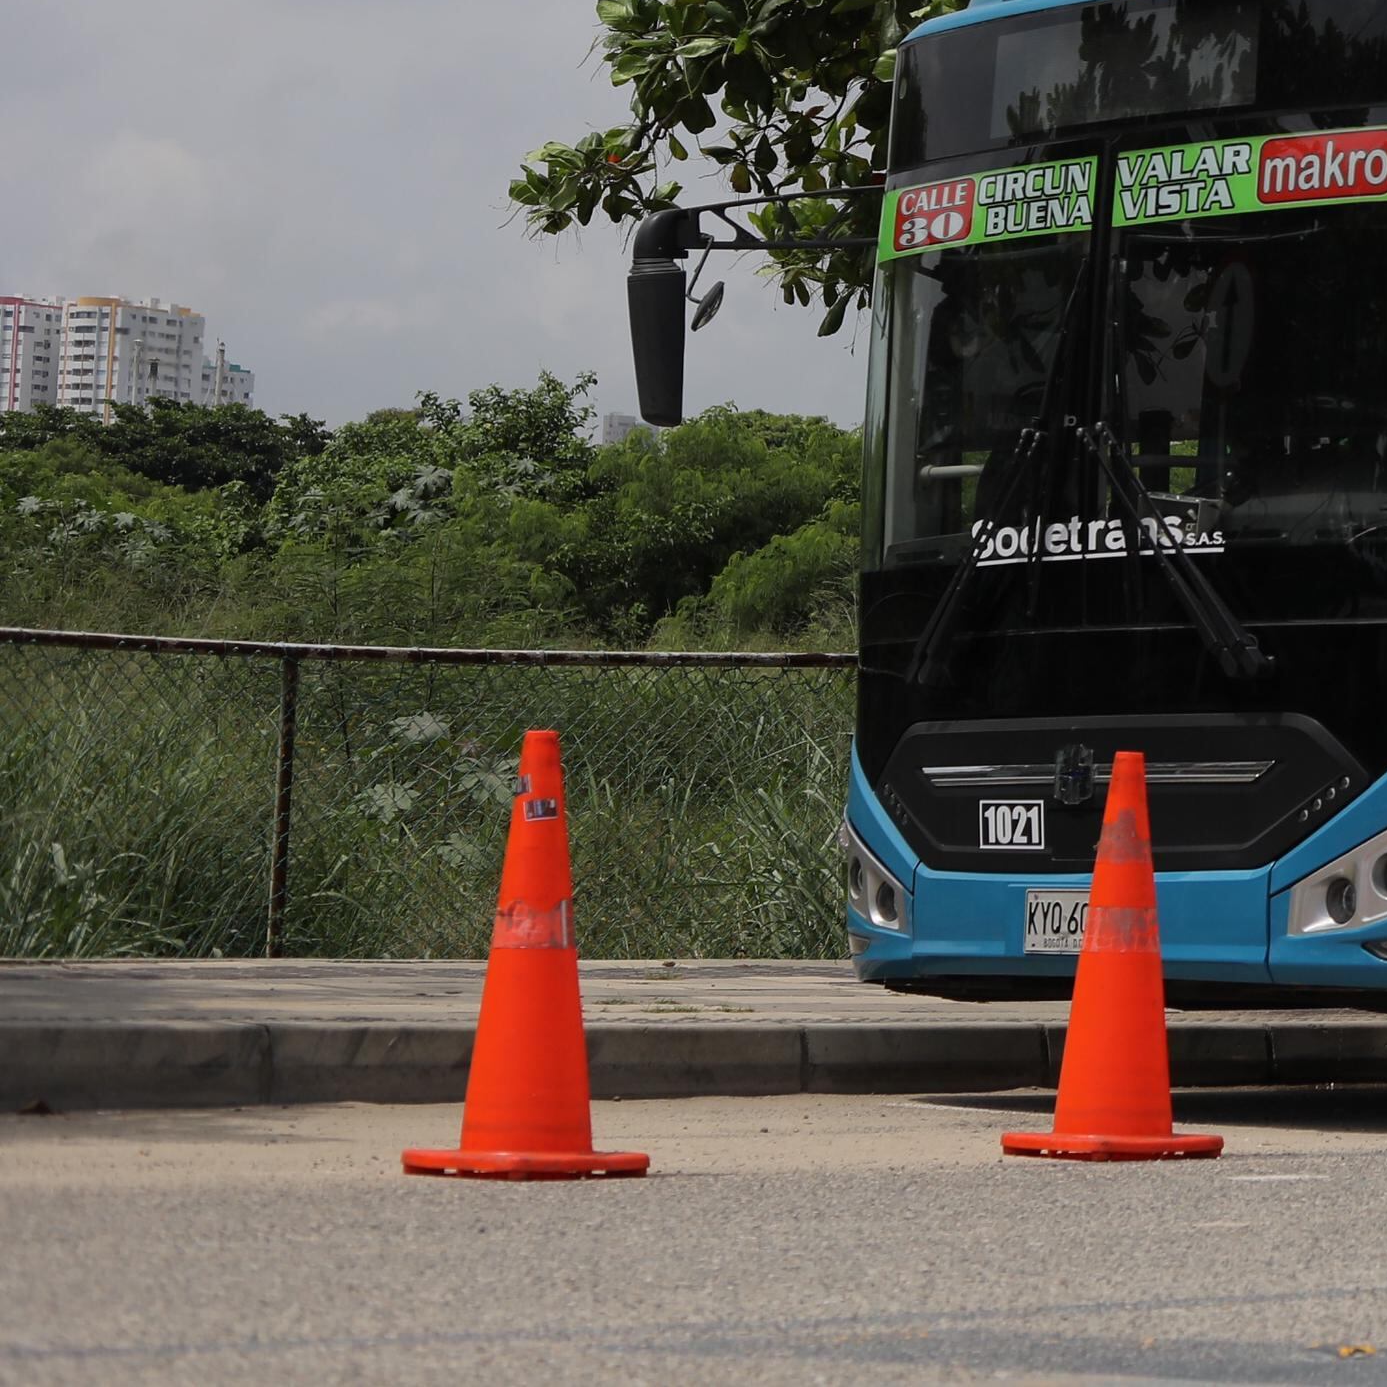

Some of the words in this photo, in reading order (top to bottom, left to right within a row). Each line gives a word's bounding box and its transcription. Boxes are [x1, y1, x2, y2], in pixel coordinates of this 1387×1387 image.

[977, 162, 1092, 207] CIRCUN
[1117, 143, 1252, 187] VALAR
[901, 181, 968, 216] CALLE
[984, 194, 1093, 237] BUENA
[1120, 179, 1235, 219] VISTA
[898, 210, 964, 247] 30
[1184, 530, 1226, 547] S.A.S.
[983, 805, 1040, 845] 1021
[1027, 901, 1063, 935] KYQ
